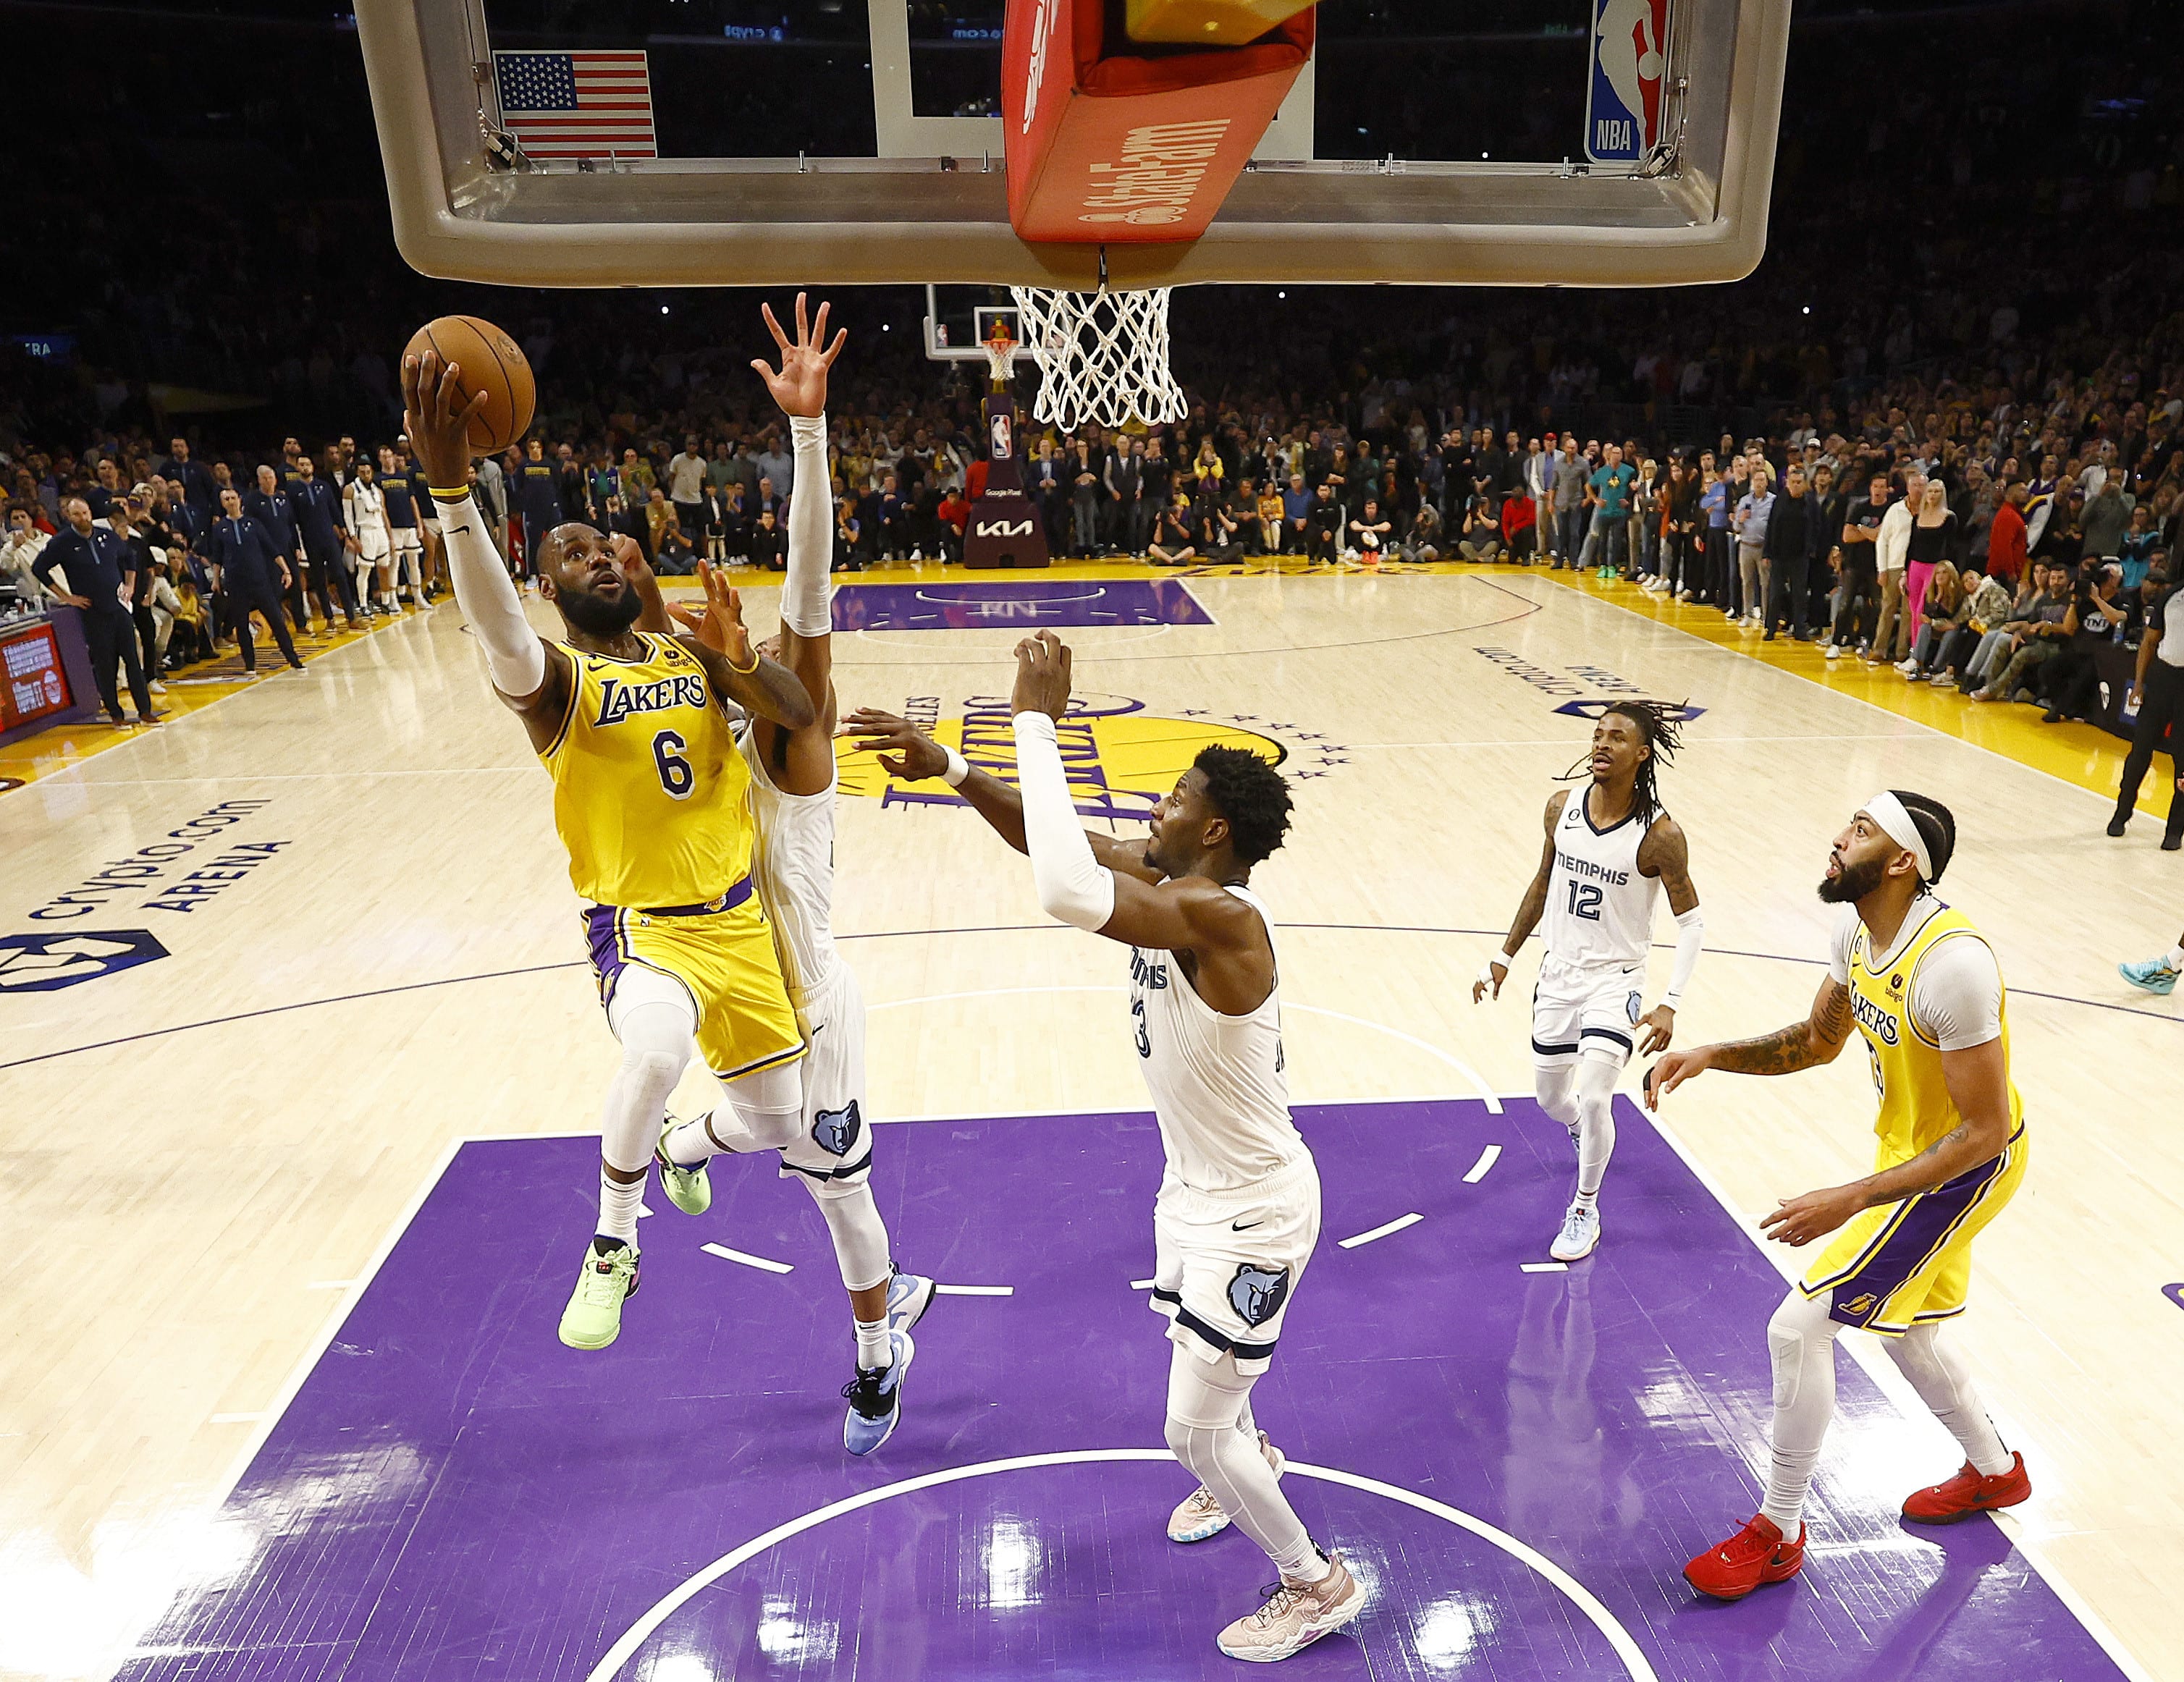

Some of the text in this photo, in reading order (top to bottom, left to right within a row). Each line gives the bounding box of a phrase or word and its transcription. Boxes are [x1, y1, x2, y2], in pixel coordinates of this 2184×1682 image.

[1596, 119, 1631, 151] NBA
[976, 520, 1034, 537] KIA
[593, 675, 708, 727] LAKERS
[650, 728, 695, 800] 6
[28, 798, 273, 920] crypto.com
[138, 840, 293, 913] ARENA
[1558, 850, 1629, 886] MEMPHIS
[1568, 879, 1603, 921] 12
[1885, 986, 1904, 1002] bibigo
[1131, 997, 1152, 1059] 3
